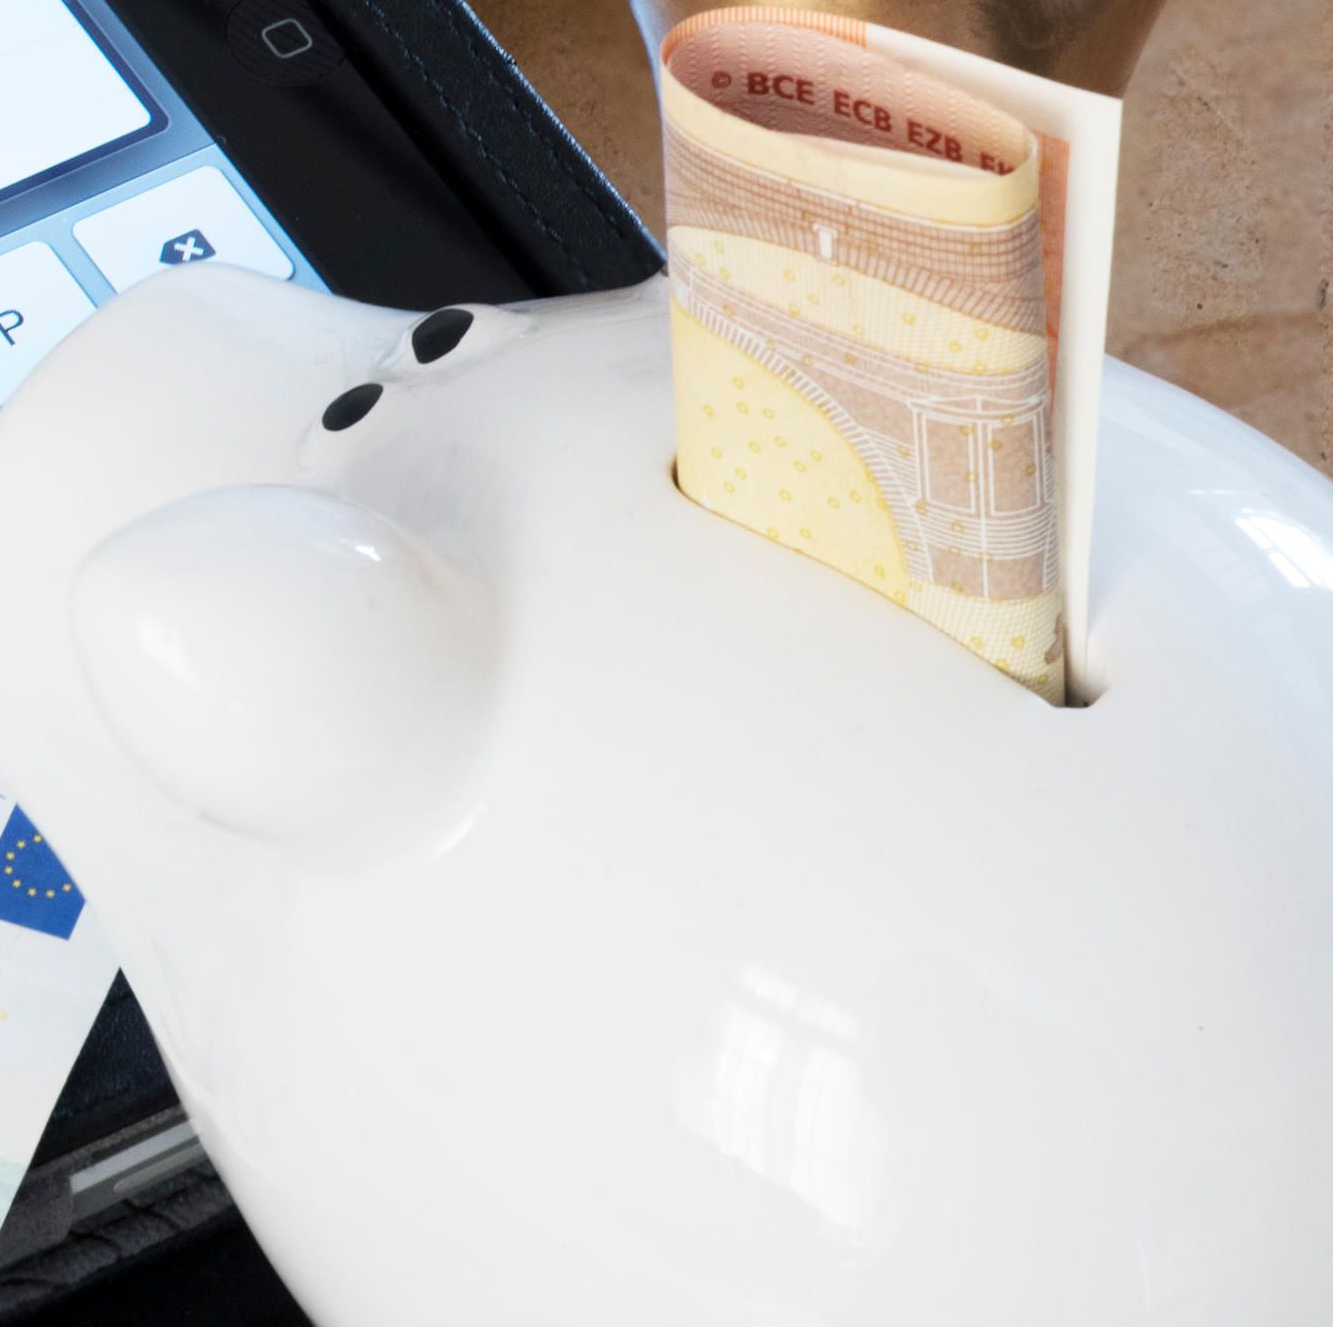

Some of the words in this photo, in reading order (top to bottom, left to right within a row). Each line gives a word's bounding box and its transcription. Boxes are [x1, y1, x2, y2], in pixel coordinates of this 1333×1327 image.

[745, 71, 816, 107] BCE
[833, 90, 893, 134] ECB
[907, 122, 965, 165] EZB
